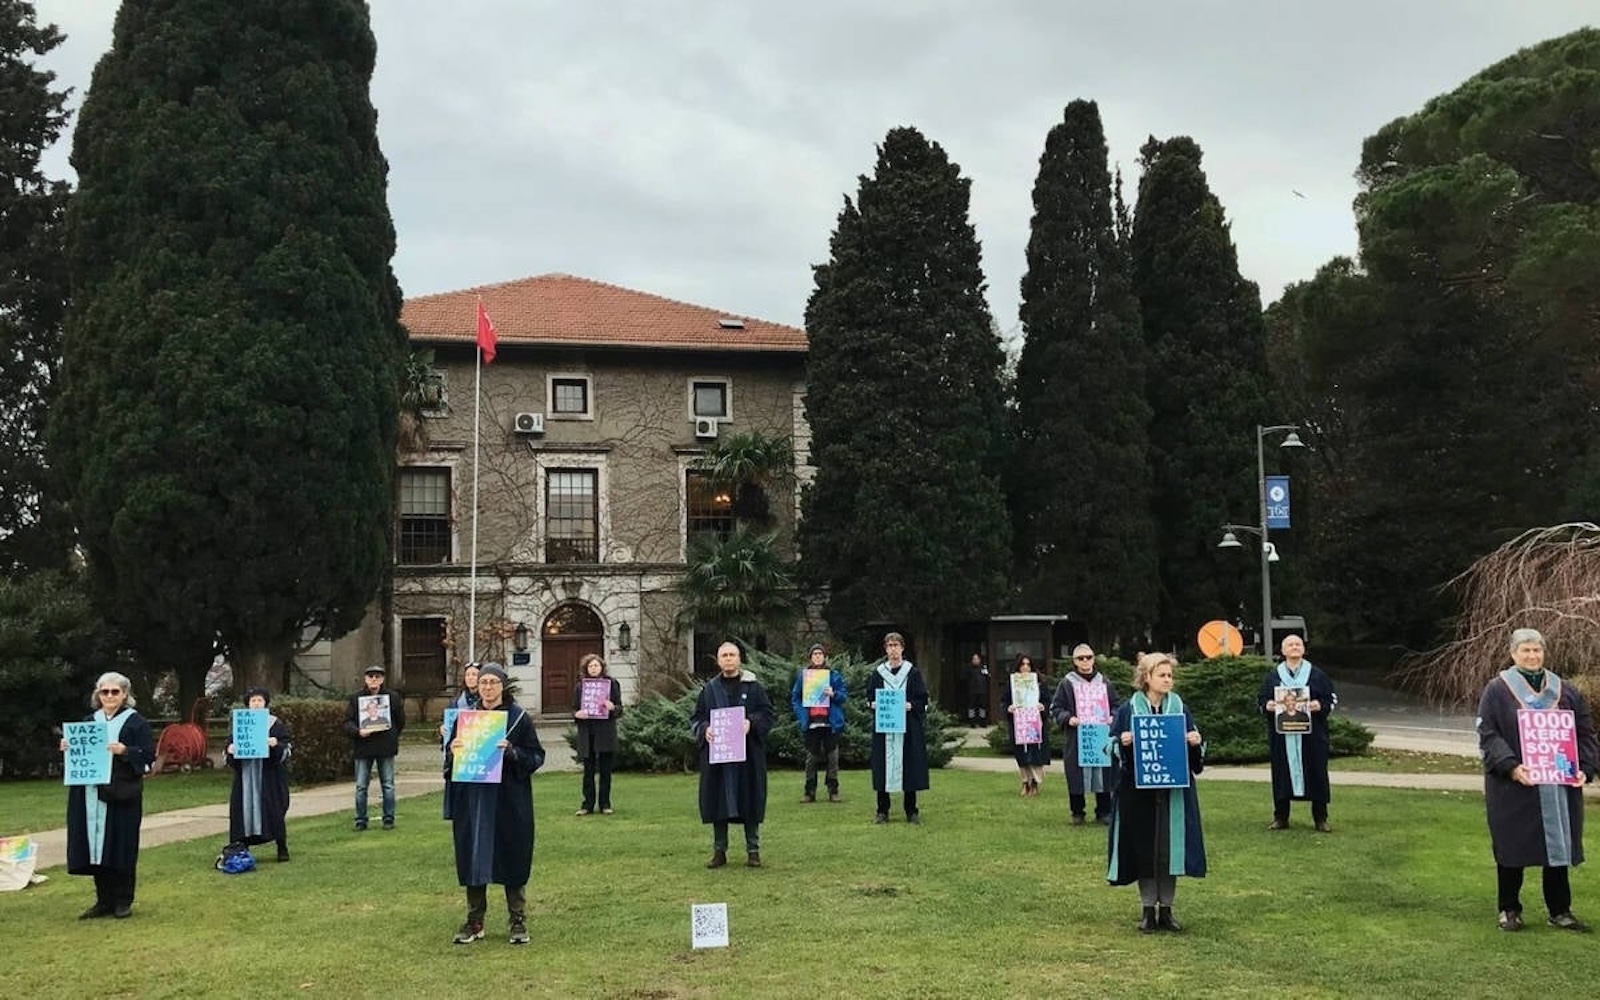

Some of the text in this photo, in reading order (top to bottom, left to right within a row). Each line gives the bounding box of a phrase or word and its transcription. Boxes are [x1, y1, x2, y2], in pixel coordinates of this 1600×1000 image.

[1140, 718, 1165, 728] KA-
[1520, 712, 1572, 728] 1000
[68, 725, 102, 734] VAZ-
[1140, 729, 1168, 738] BUL
[1524, 728, 1570, 740] KERE
[70, 736, 104, 746] GEÇ-
[1140, 740, 1163, 750] ET-
[70, 745, 92, 756] Mİ-
[1142, 750, 1164, 761] Mİ-
[71, 758, 95, 768] YO-
[1142, 762, 1168, 772] YO-
[1527, 756, 1555, 768] LE-
[71, 770, 102, 778] RUZ.
[1142, 774, 1176, 784] RUZ.
